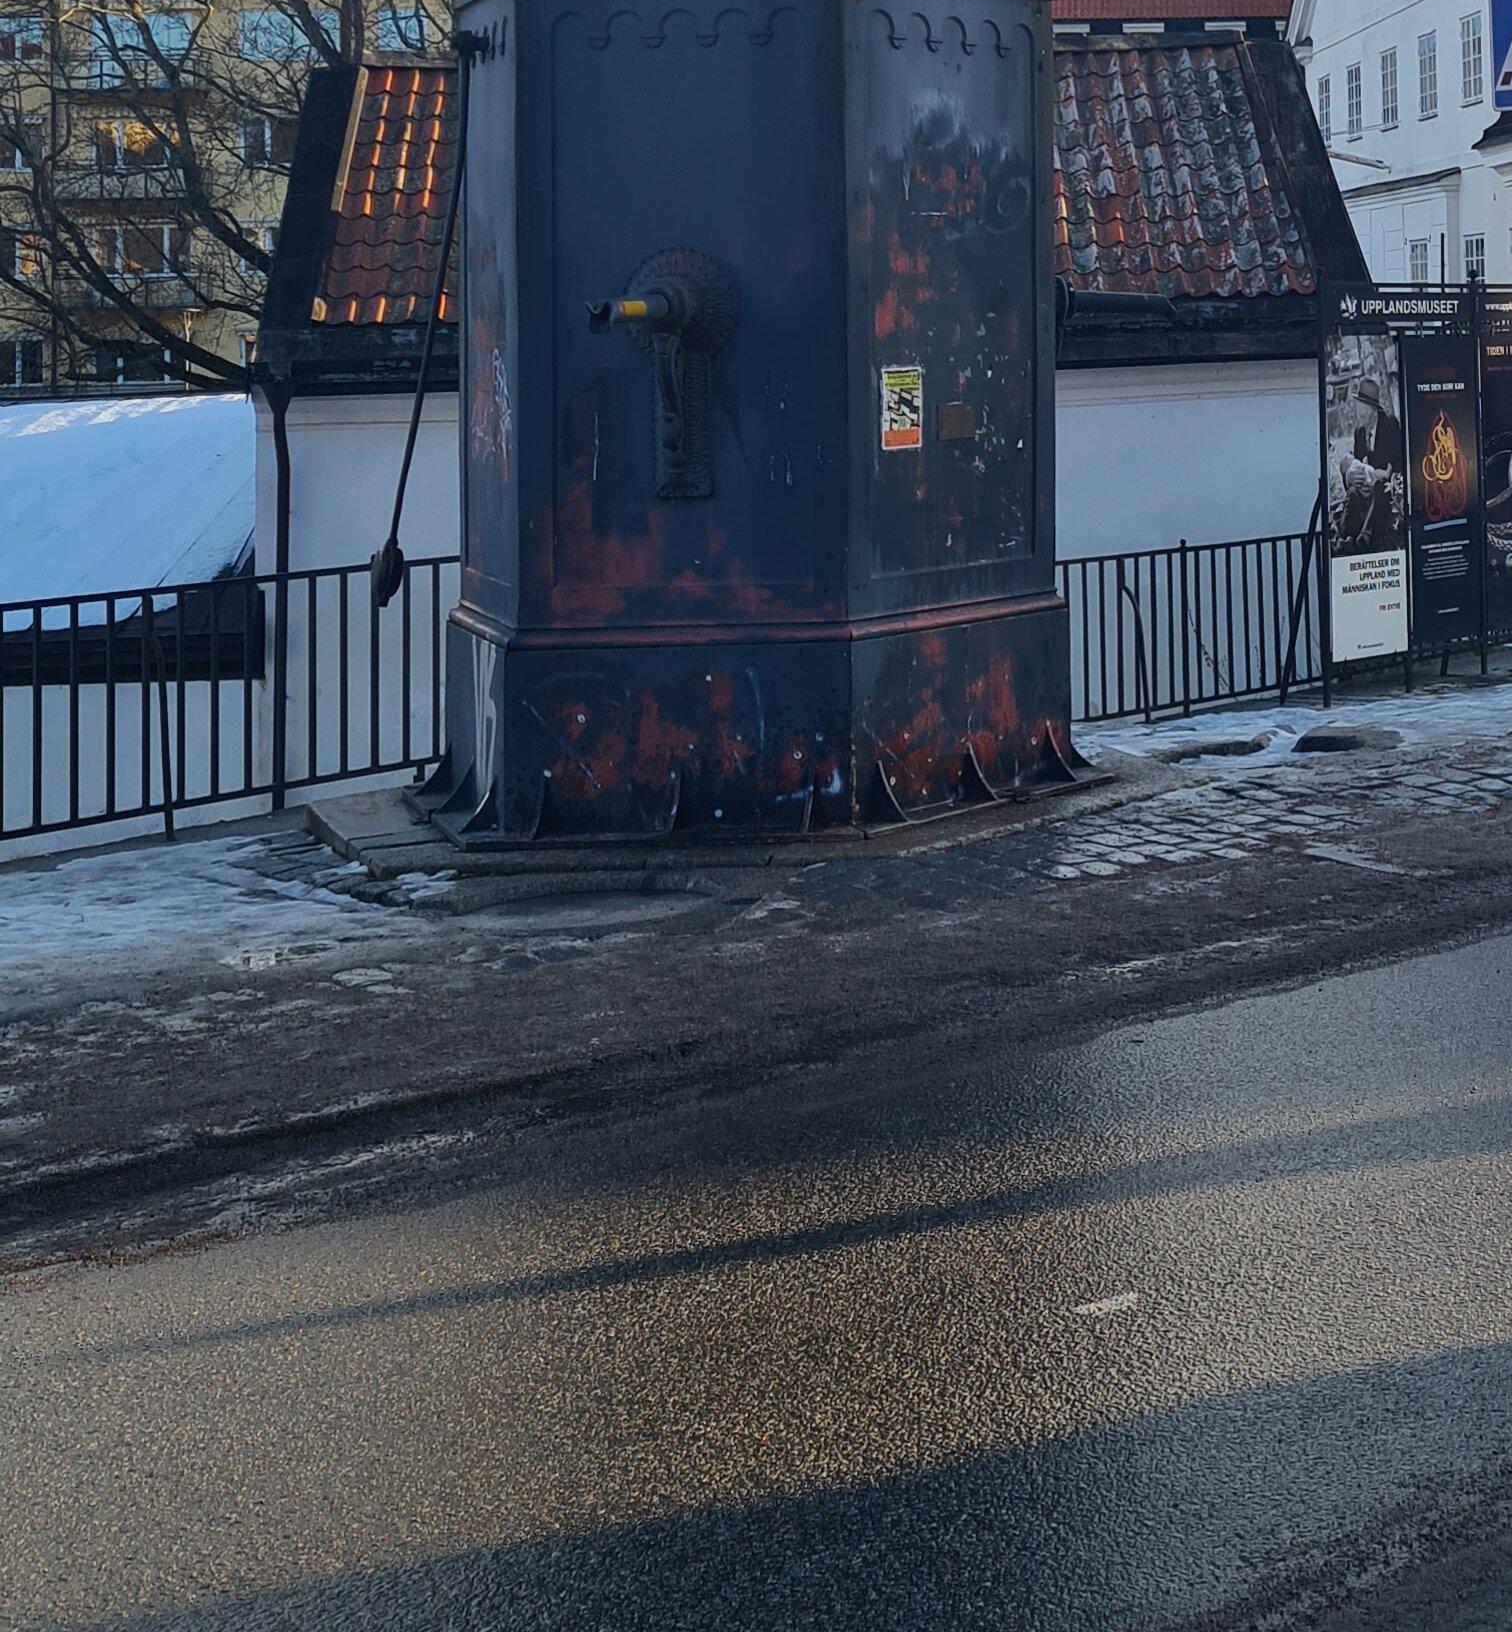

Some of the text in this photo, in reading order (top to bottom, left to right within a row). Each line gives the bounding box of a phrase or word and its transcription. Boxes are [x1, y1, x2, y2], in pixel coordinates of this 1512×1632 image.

[1361, 299, 1459, 314] UPPLANDSMUSEET
[1390, 558, 1400, 566] OM
[1360, 569, 1400, 581] UPPLAND MED
[1381, 580, 1400, 590] FOKUS
